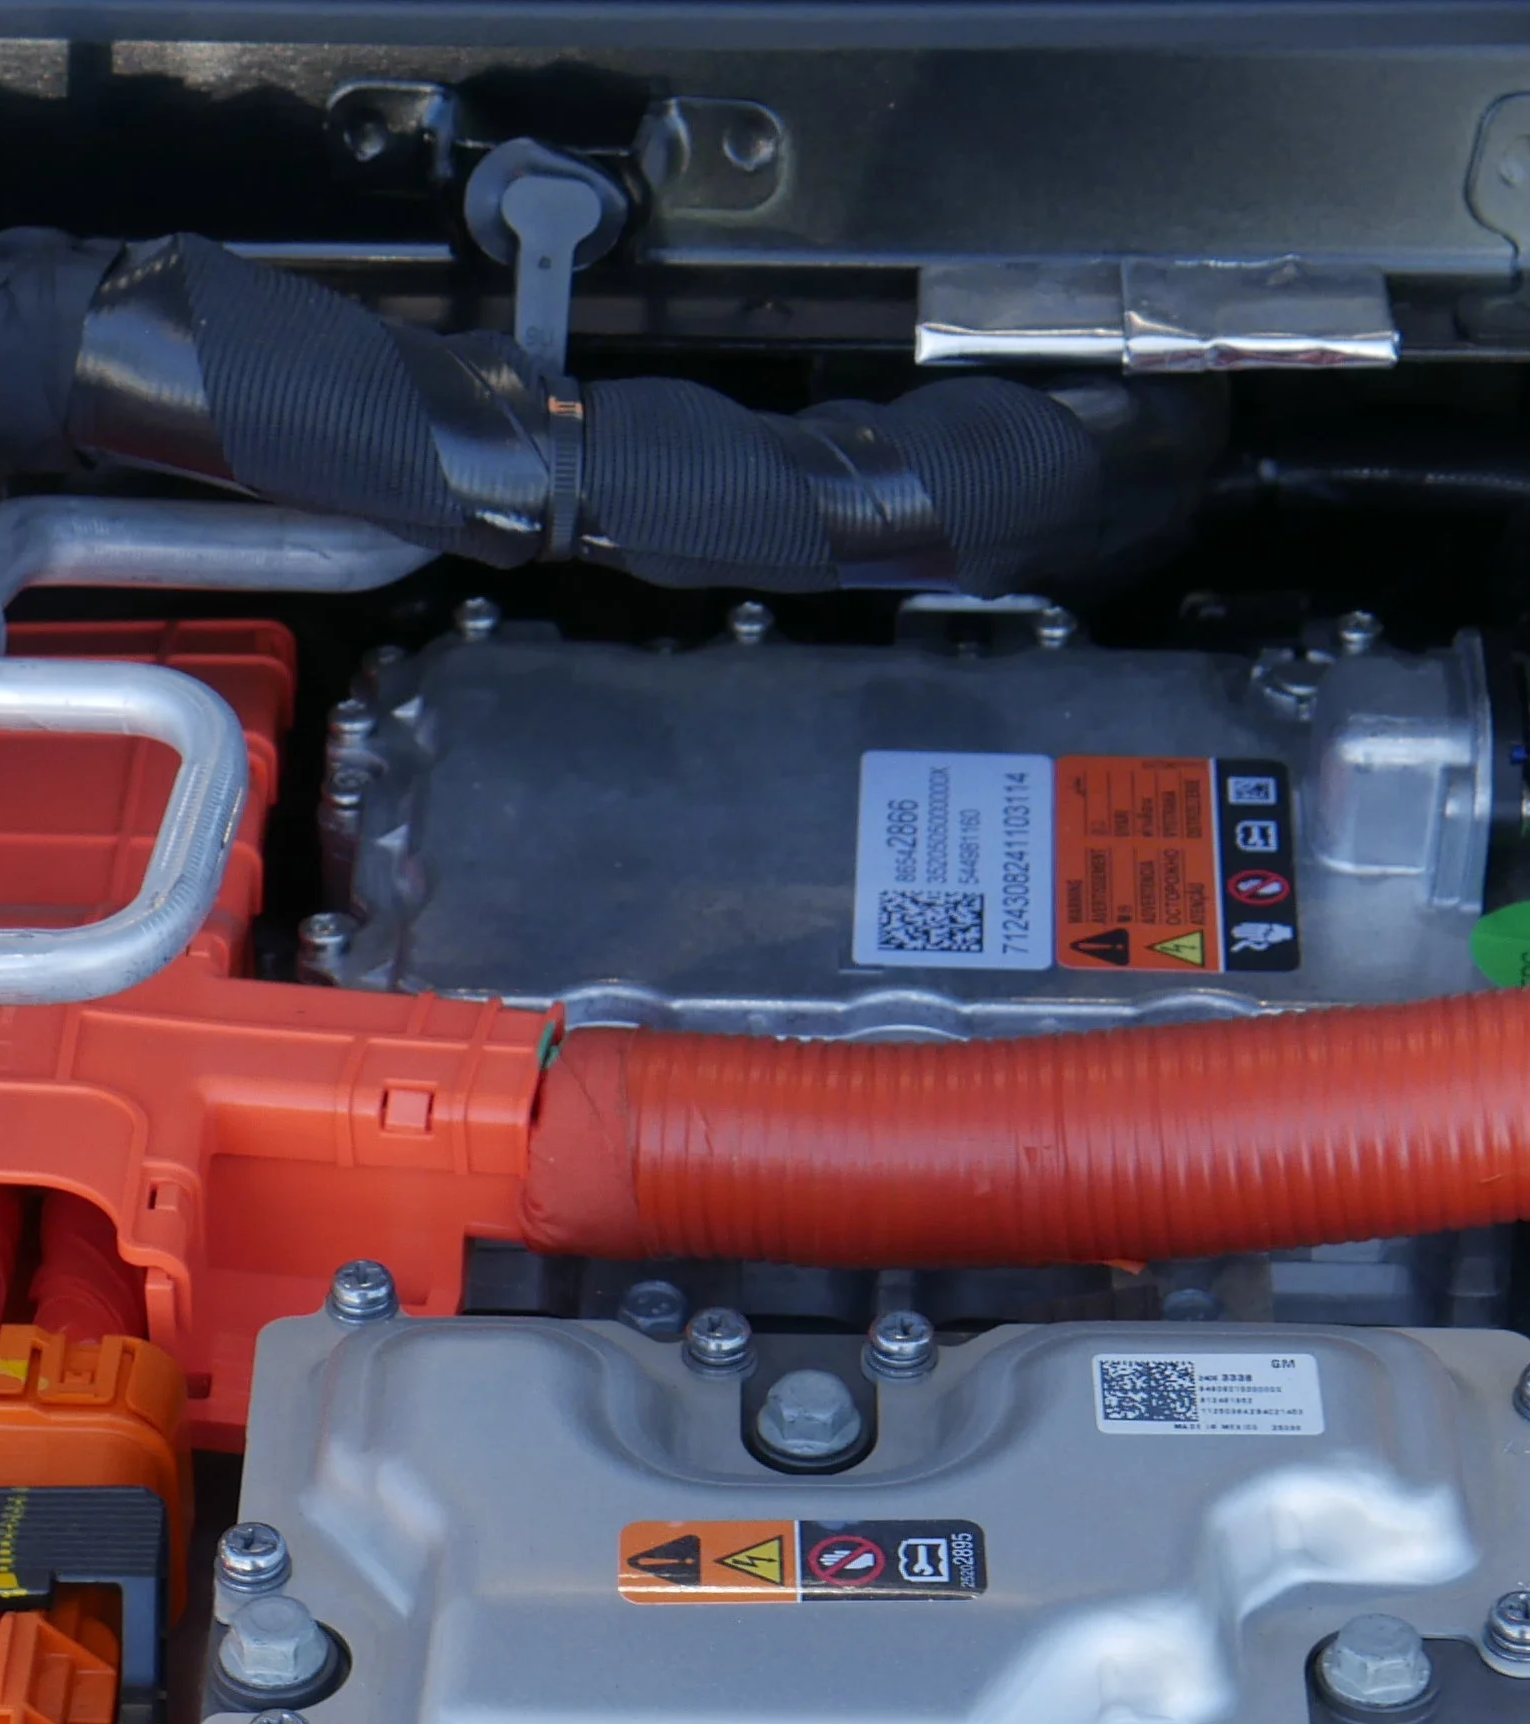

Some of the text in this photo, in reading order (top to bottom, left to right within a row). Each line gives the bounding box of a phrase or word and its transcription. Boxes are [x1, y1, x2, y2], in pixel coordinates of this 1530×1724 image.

[886, 798, 918, 883] 86542866
[1002, 772, 1031, 954] 7124308241103114
[1162, 849, 1182, 925] ОСТОРОЖНО
[1271, 1359, 1295, 1368] GM
[952, 1533, 975, 1588] 25202895
